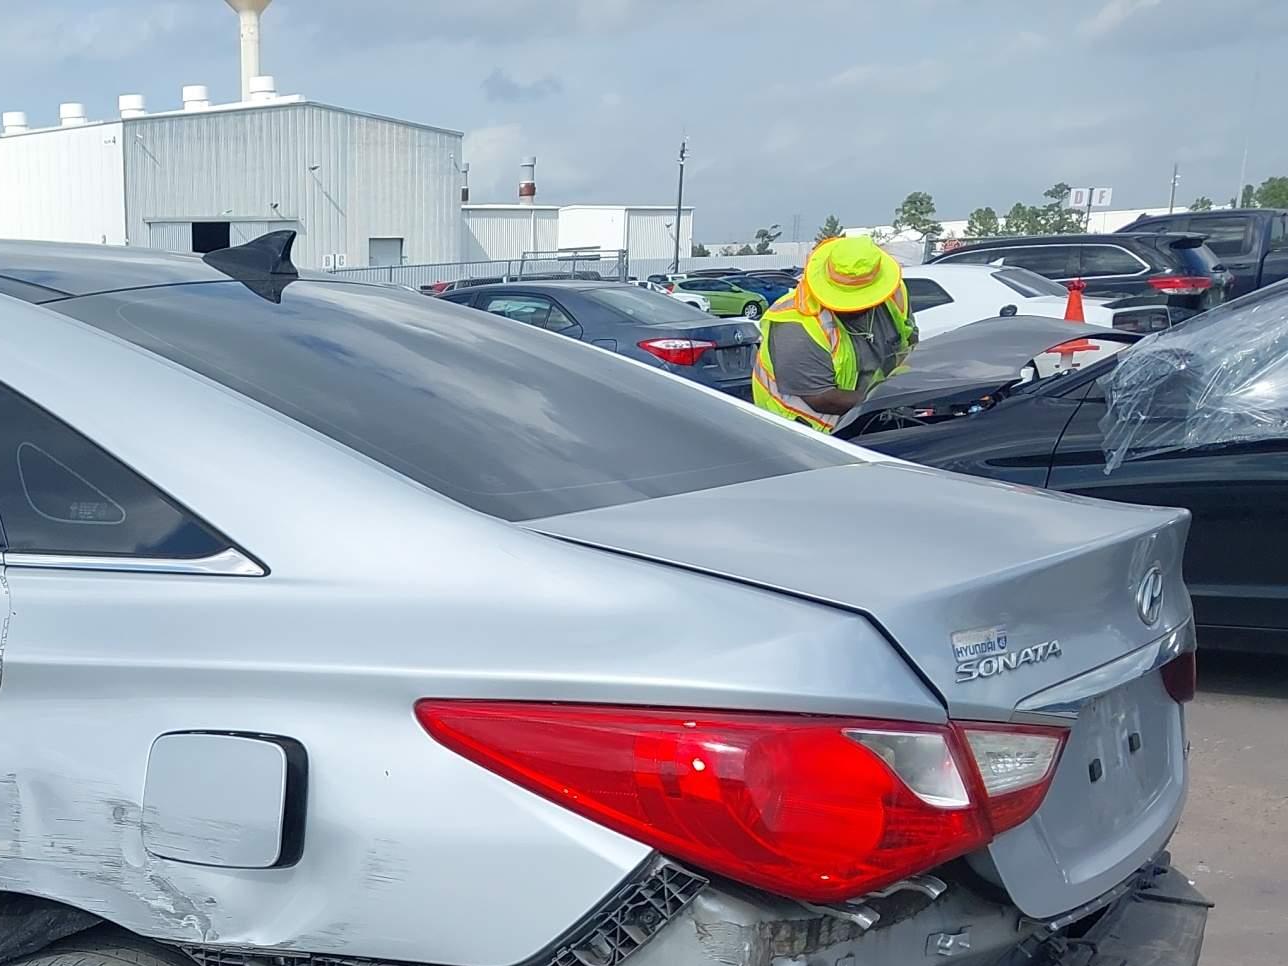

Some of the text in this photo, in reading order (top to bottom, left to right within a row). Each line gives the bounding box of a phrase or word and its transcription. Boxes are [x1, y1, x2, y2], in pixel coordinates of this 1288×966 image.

[1074, 190, 1084, 205] D
[1098, 190, 1107, 204] F
[338, 255, 345, 266] C
[955, 640, 996, 658] HYUNDAI
[955, 640, 1062, 683] SONATA
